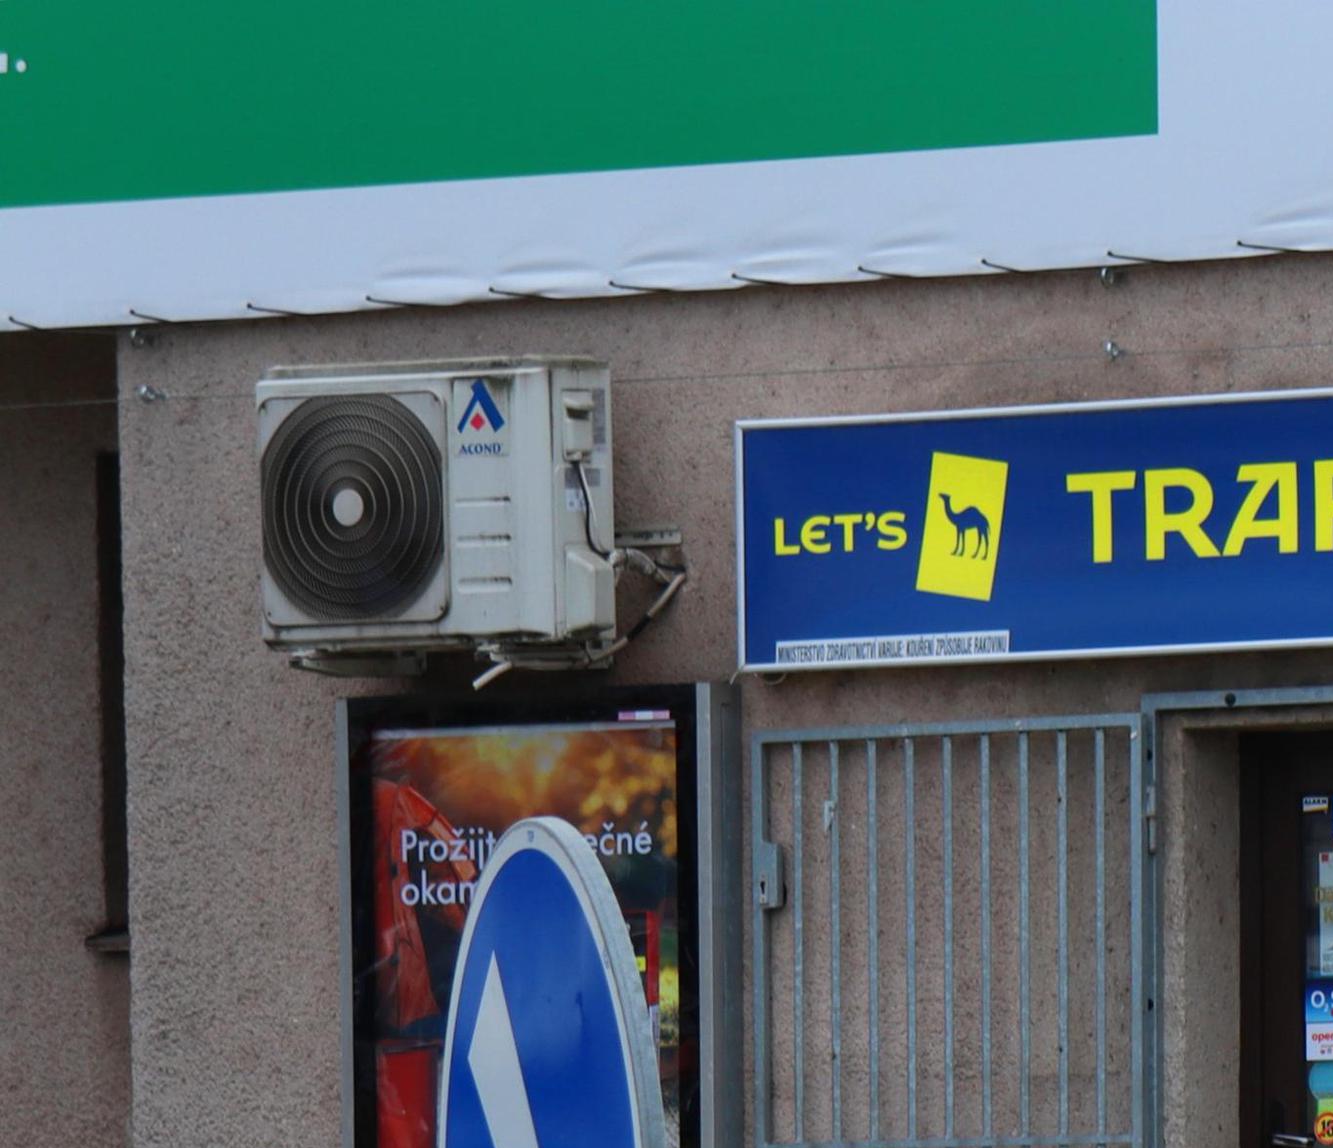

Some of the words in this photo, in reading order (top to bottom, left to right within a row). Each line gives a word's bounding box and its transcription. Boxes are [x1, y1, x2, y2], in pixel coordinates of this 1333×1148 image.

[459, 442, 502, 456] ACOND
[773, 511, 908, 556] LET'S
[401, 827, 497, 870] Prožijt
[583, 820, 653, 856] ečné
